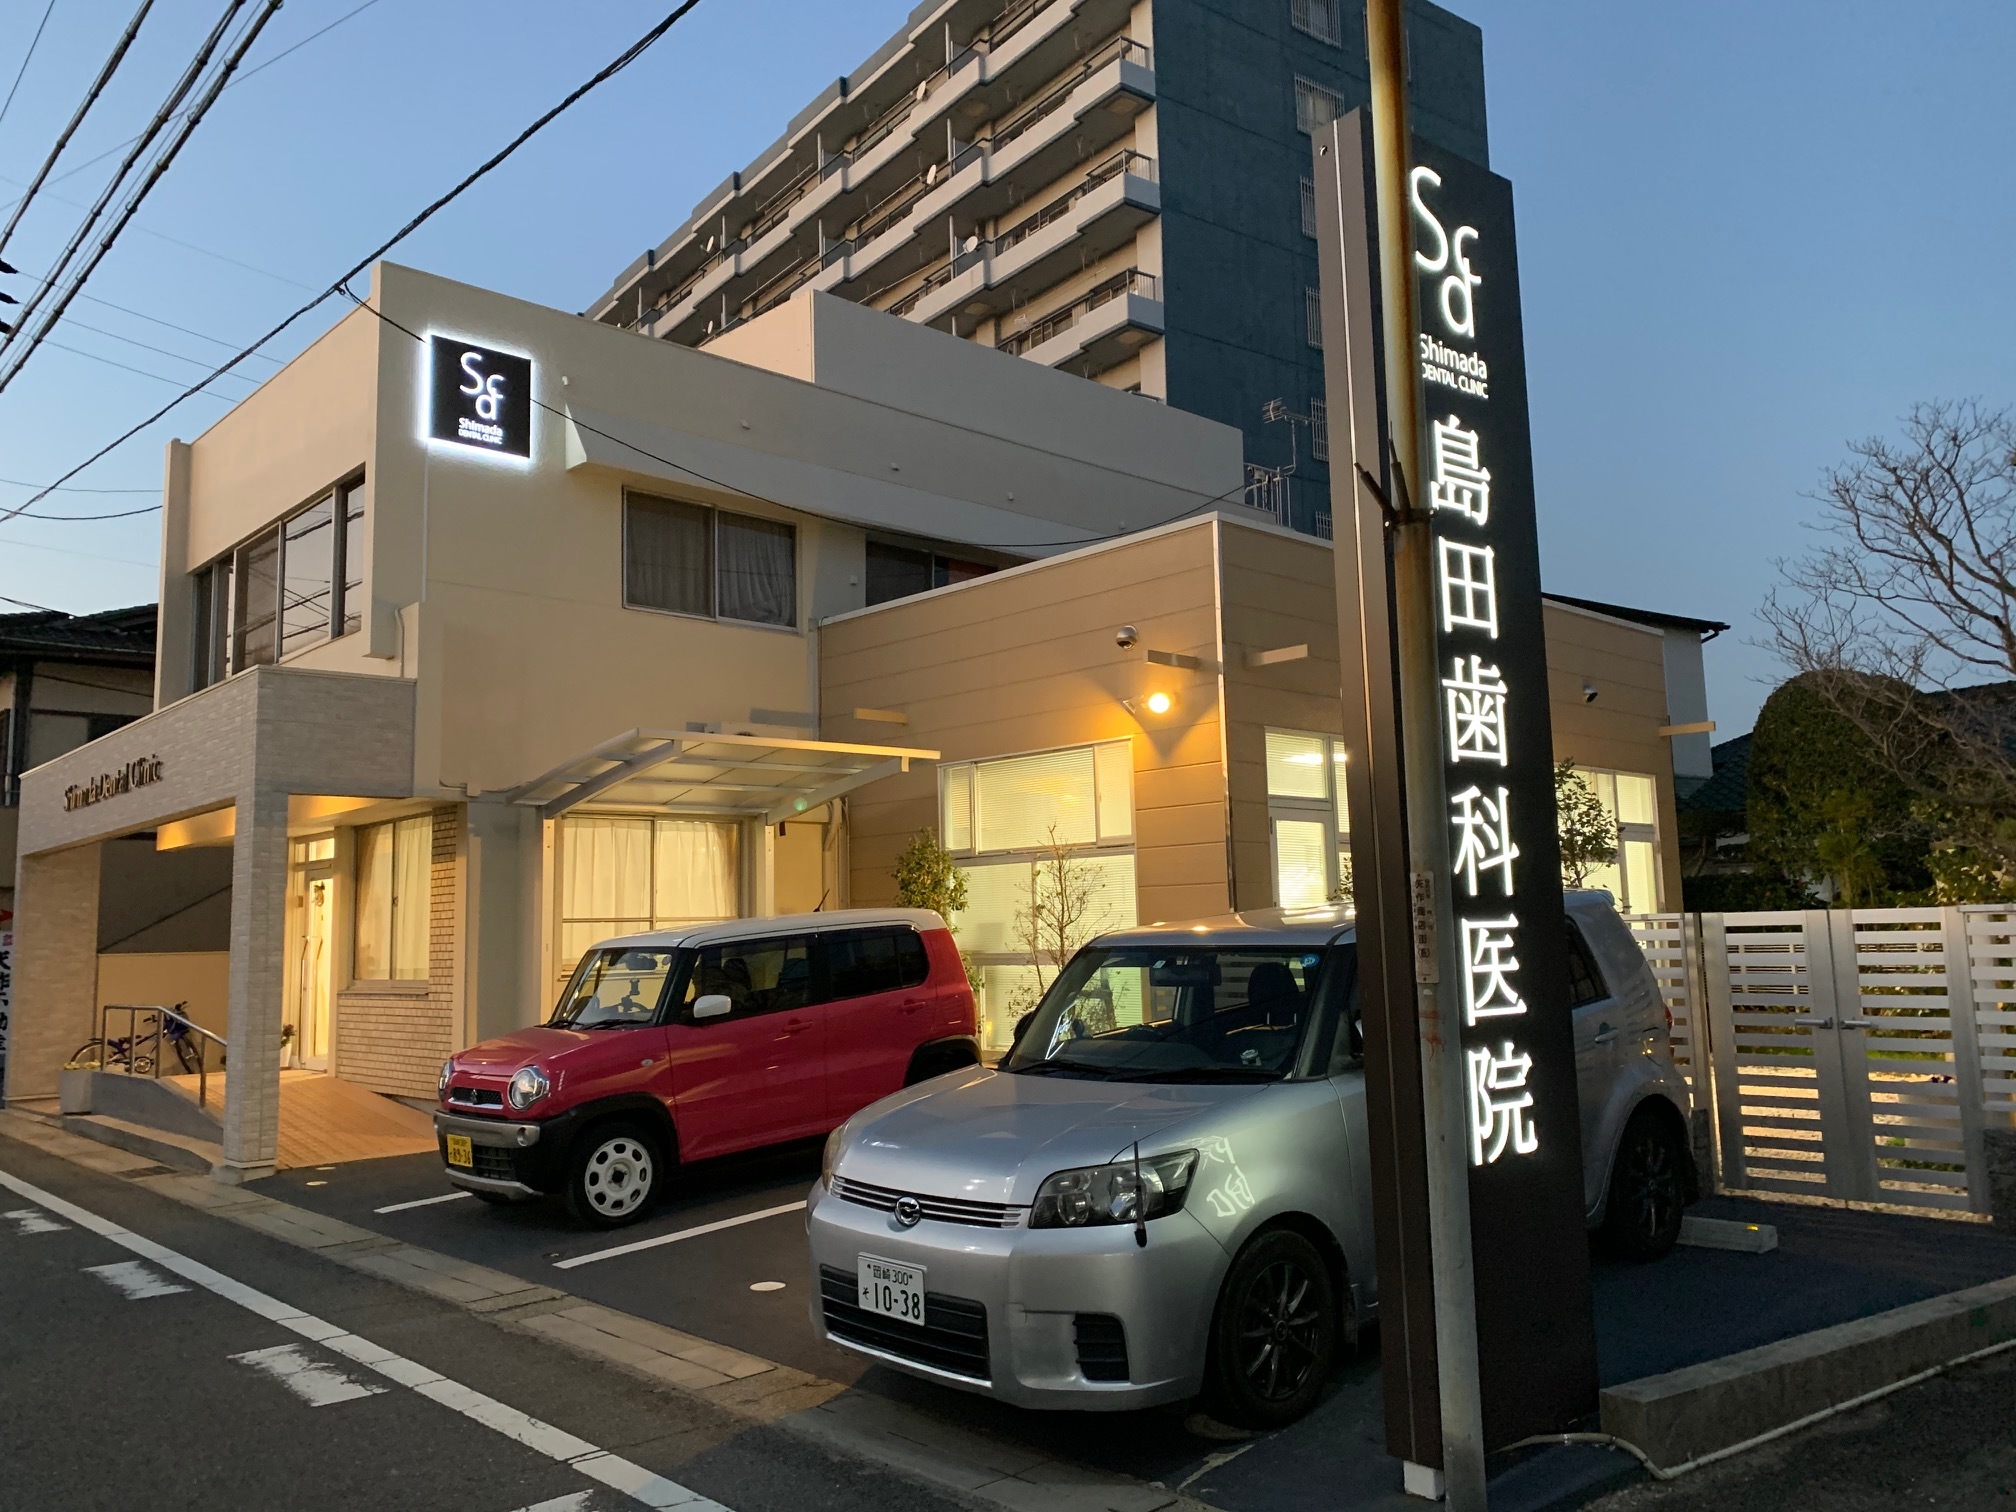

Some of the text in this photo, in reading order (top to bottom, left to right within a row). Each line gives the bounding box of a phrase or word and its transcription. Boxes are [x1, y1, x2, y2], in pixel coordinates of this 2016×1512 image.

[1420, 333, 1487, 379] Shimada
[1458, 374, 1489, 399] CLINIC
[458, 417, 504, 437] Shimada
[130, 753, 164, 788] Clinic
[1430, 413, 1539, 1167] 島田歯科医院
[892, 1269, 909, 1286] 300
[874, 1282, 920, 1320] 10-38
